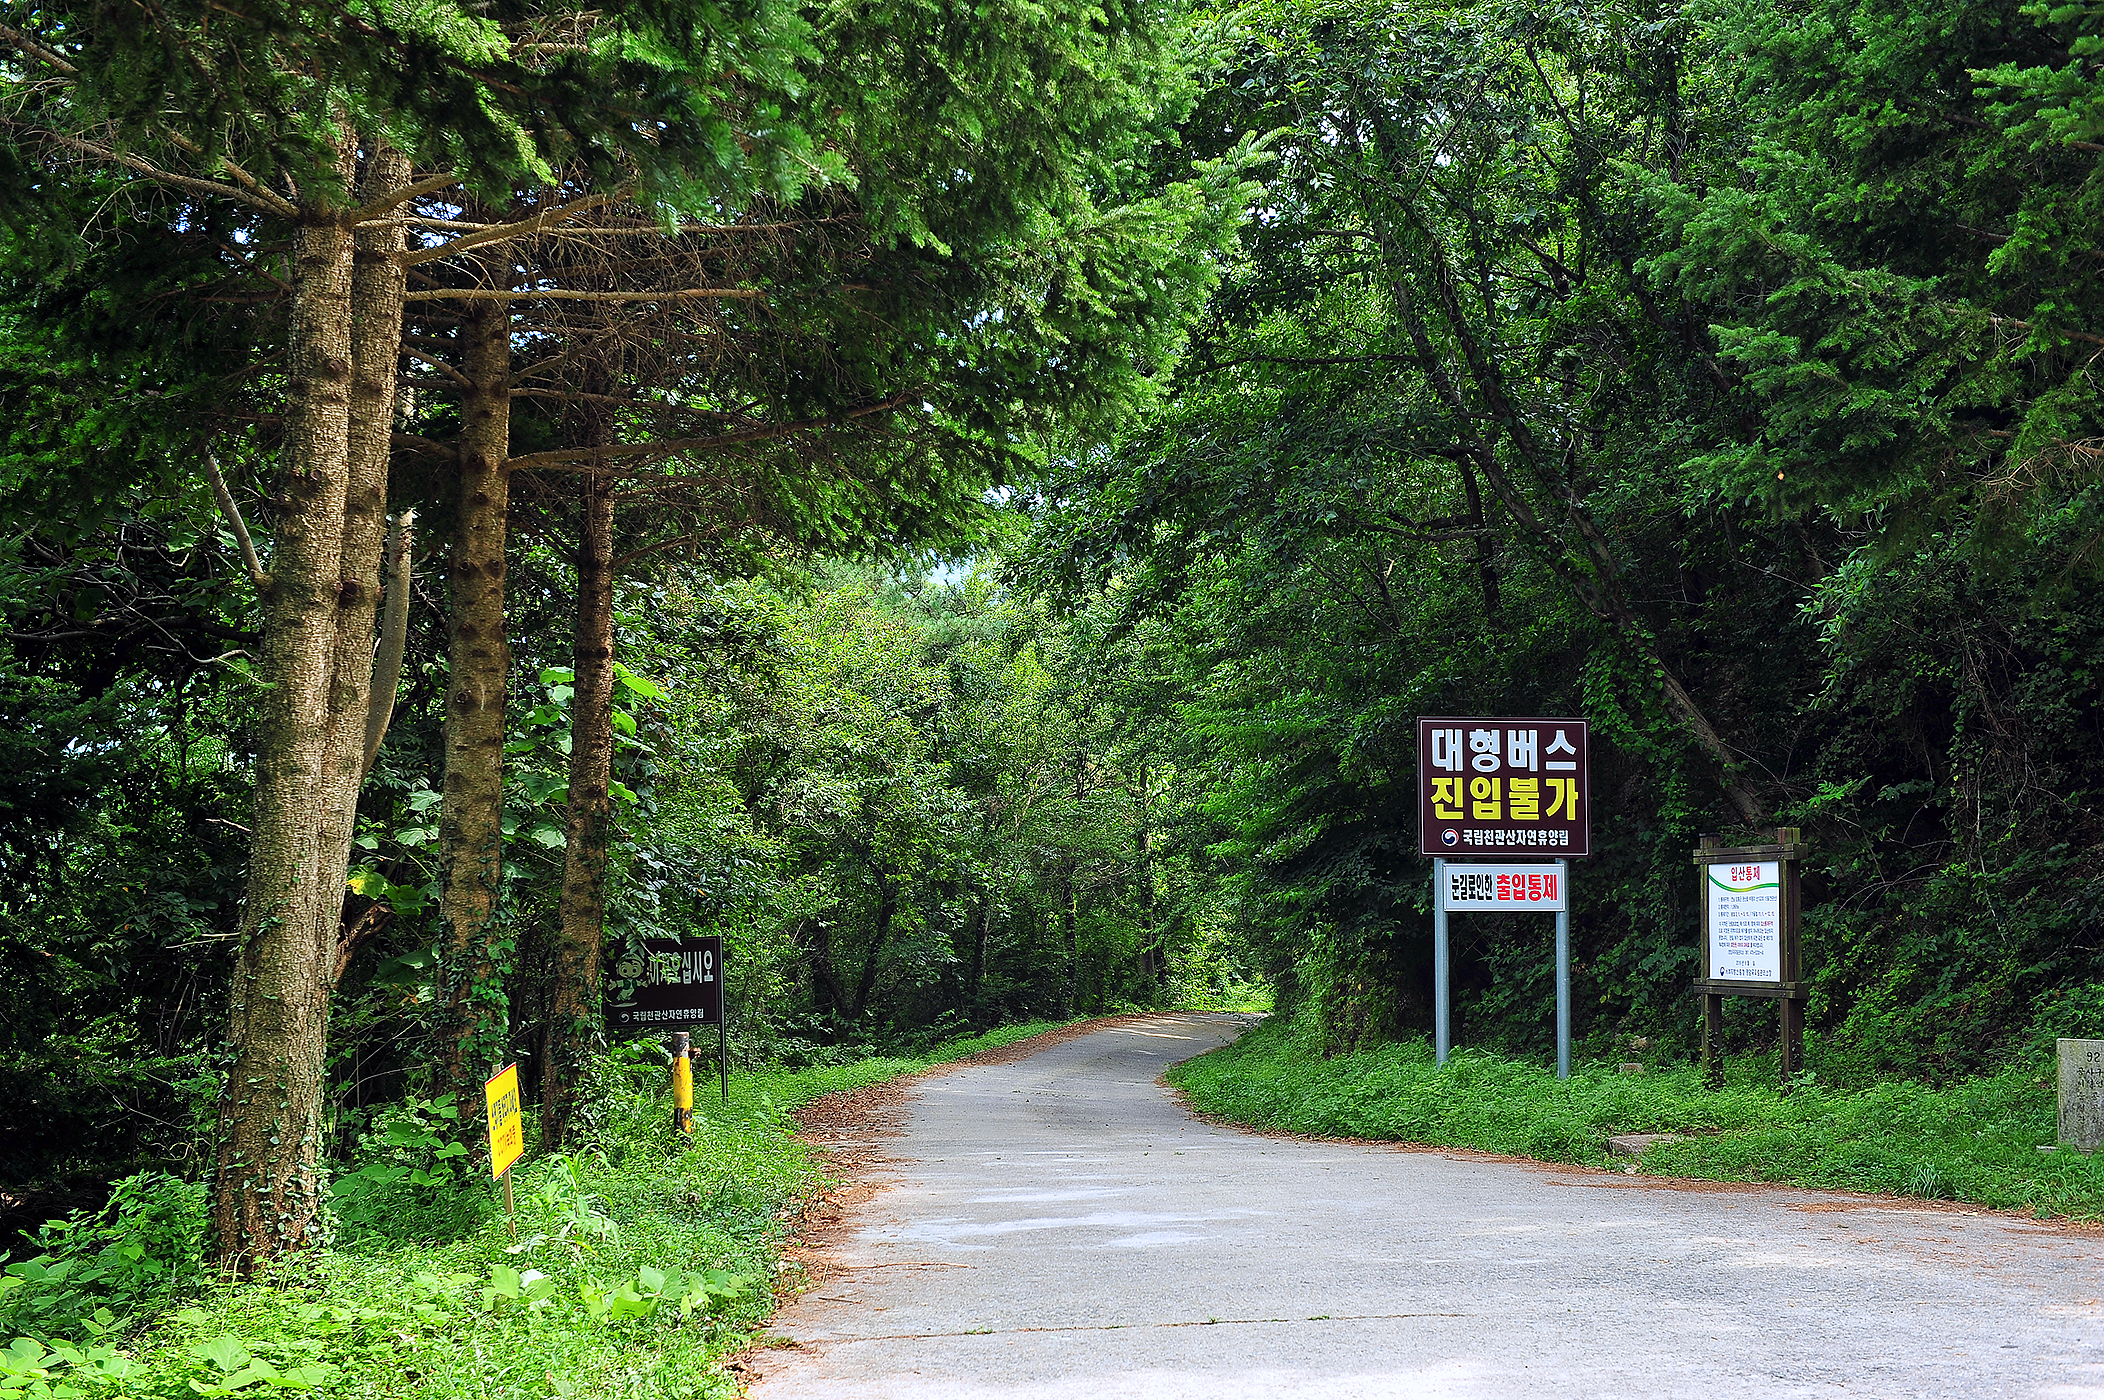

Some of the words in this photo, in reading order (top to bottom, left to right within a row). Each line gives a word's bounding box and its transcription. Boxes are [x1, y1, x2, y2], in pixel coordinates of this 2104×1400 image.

[1431, 728, 1577, 773] 대형버스
[1430, 776, 1579, 821] 진입불가
[1462, 829, 1569, 847] 국립천관산자연휴양림
[1731, 865, 1761, 882] 입산통제
[1451, 873, 1493, 901] 눈길로인한
[1496, 873, 1558, 901] 출입통제
[632, 1008, 704, 1022] 국립천관산자연휴양림
[2086, 1051, 2101, 1063] 92
